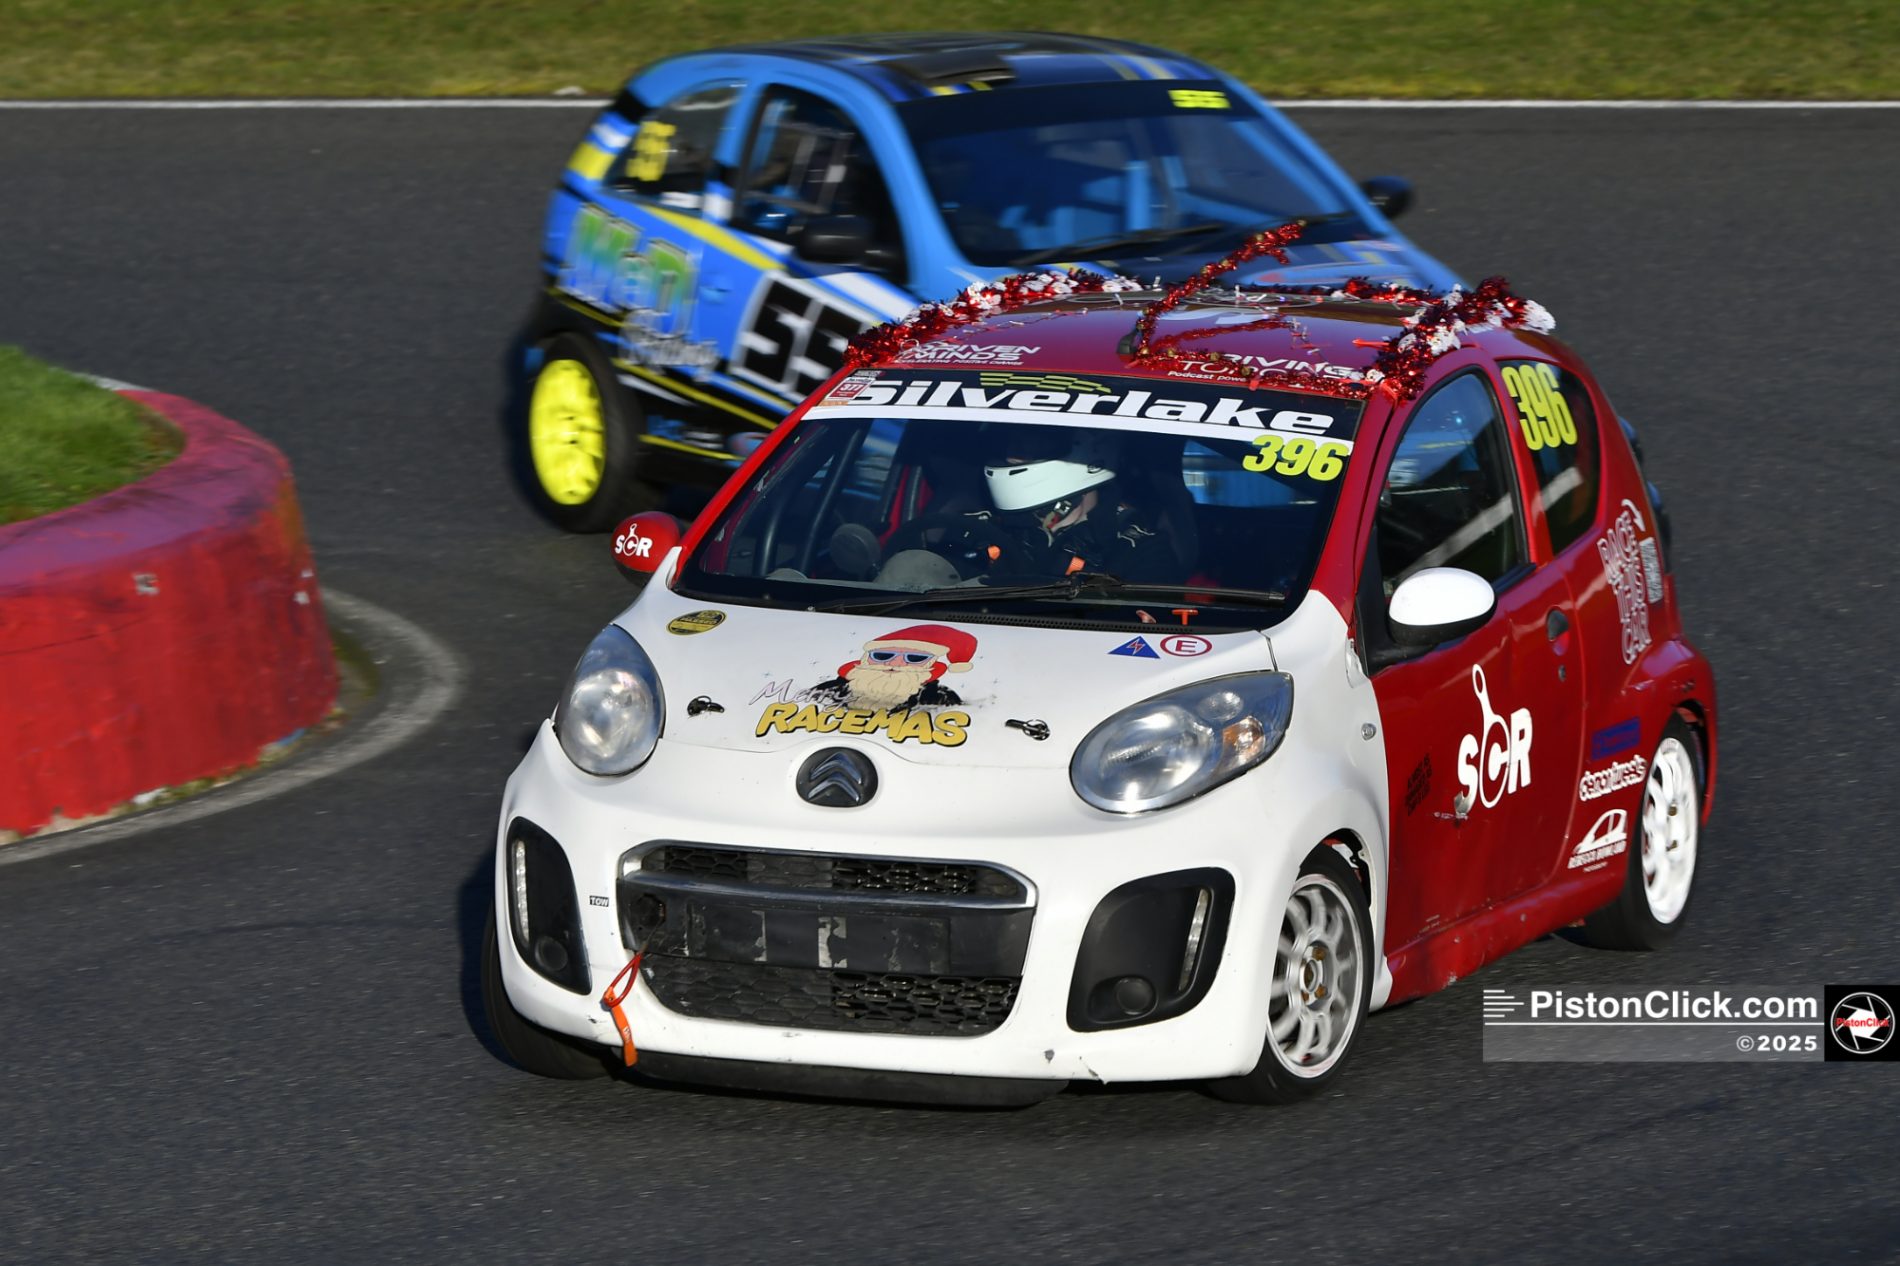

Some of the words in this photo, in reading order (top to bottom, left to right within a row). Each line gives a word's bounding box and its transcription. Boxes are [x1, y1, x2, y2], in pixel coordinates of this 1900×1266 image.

[914, 350, 1023, 361] MINDS
[916, 342, 1041, 354] DRIVEN
[1168, 370, 1214, 380] Podcast
[1223, 354, 1362, 380] RIVING
[859, 380, 1334, 435] Silverlake
[1501, 362, 1577, 451] 396
[1242, 435, 1350, 481] 396
[614, 531, 654, 558] SCR
[1175, 639, 1197, 653] E
[749, 678, 860, 712] Merry
[756, 702, 971, 747] RACEMAS
[1455, 707, 1533, 812] SCR
[590, 896, 609, 907] TOW
